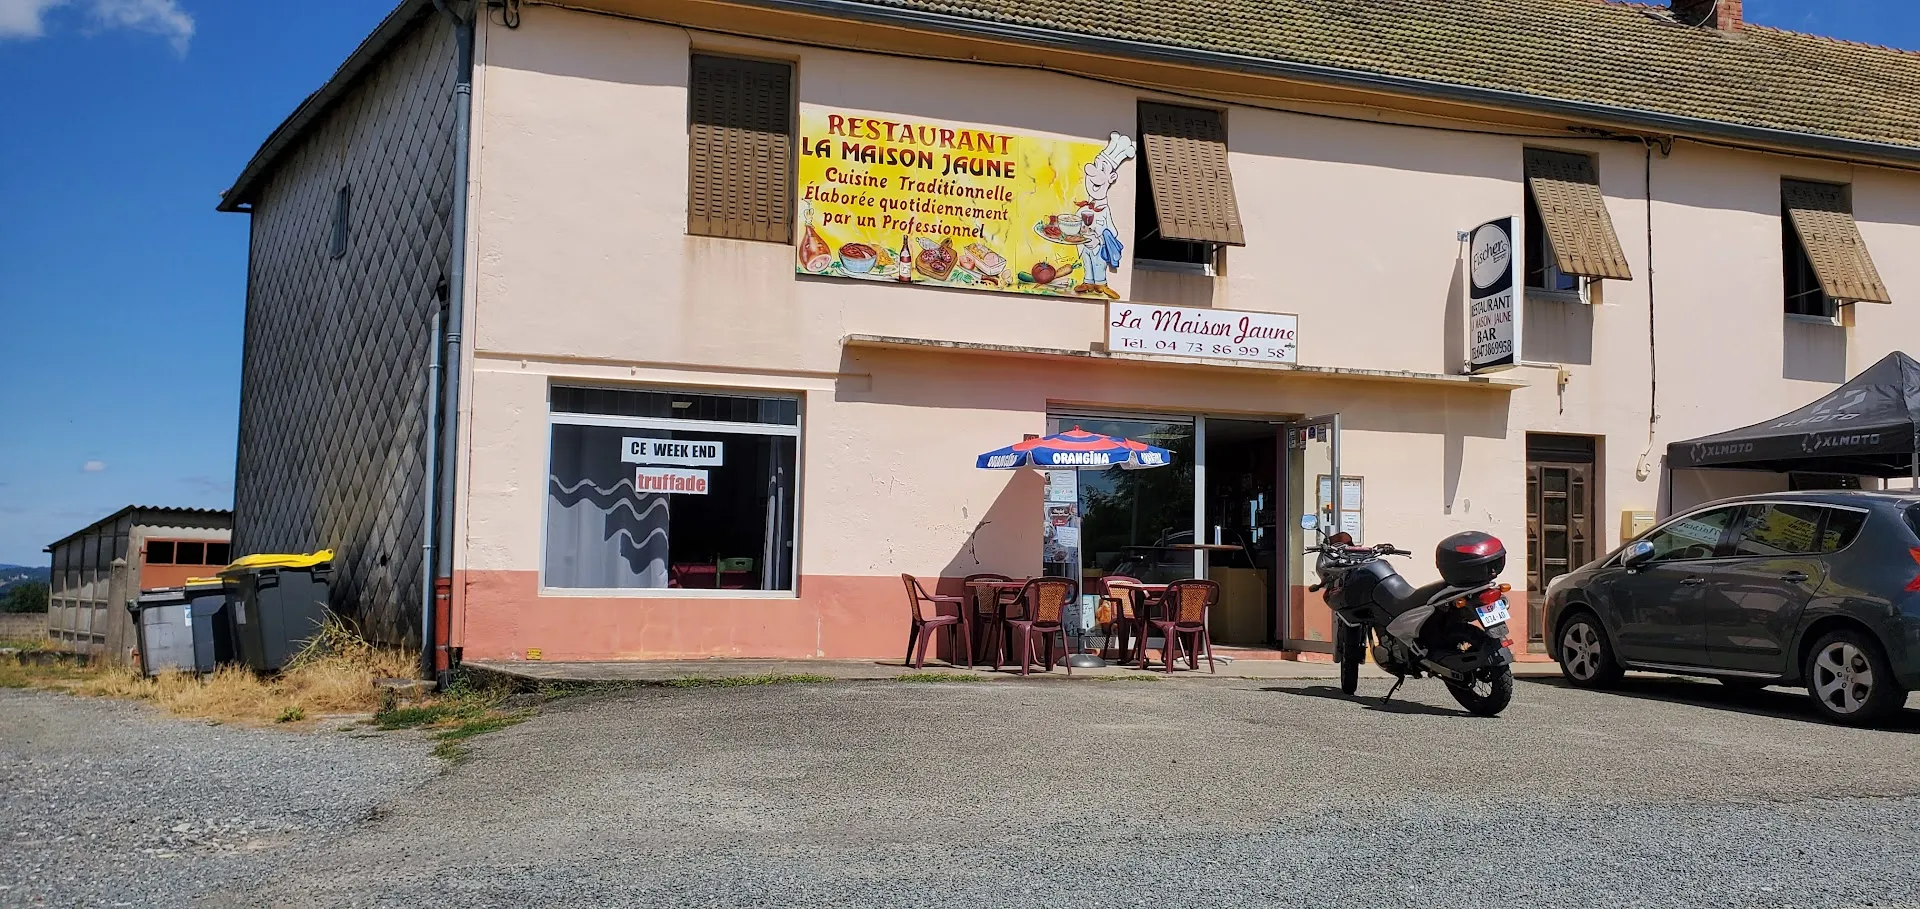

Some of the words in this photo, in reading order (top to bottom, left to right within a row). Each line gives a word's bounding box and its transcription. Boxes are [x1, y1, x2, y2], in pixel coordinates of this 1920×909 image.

[827, 114, 1014, 156] RESTAURANT
[802, 137, 831, 159] LA
[841, 141, 933, 170] MAISON
[942, 153, 1016, 179] JAUNE
[825, 167, 888, 189] Cuisine
[899, 176, 1013, 202] Traditionnelle
[804, 180, 875, 208] Élaborée
[879, 198, 1008, 221] quotidiennement
[823, 211, 851, 227] par
[857, 215, 877, 229] un
[882, 215, 985, 239] Professionnel
[1473, 239, 1504, 273] Fischer
[1111, 309, 1142, 330] La
[1151, 310, 1231, 337] Maison
[1233, 316, 1295, 344] Jaune
[1493, 310, 1512, 327] JAUNE
[1121, 337, 1147, 349] Tél.
[1155, 340, 1177, 351] 04
[1186, 342, 1203, 353] 73
[1212, 344, 1232, 355] 86
[1238, 346, 1259, 357] 99
[1267, 348, 1285, 359] 58
[1477, 327, 1497, 344] BAR
[631, 441, 647, 456] CE
[654, 443, 689, 458] WEEK
[692, 445, 716, 459] END
[1822, 434, 1881, 447] XLMOTO
[638, 474, 706, 492] truffade
